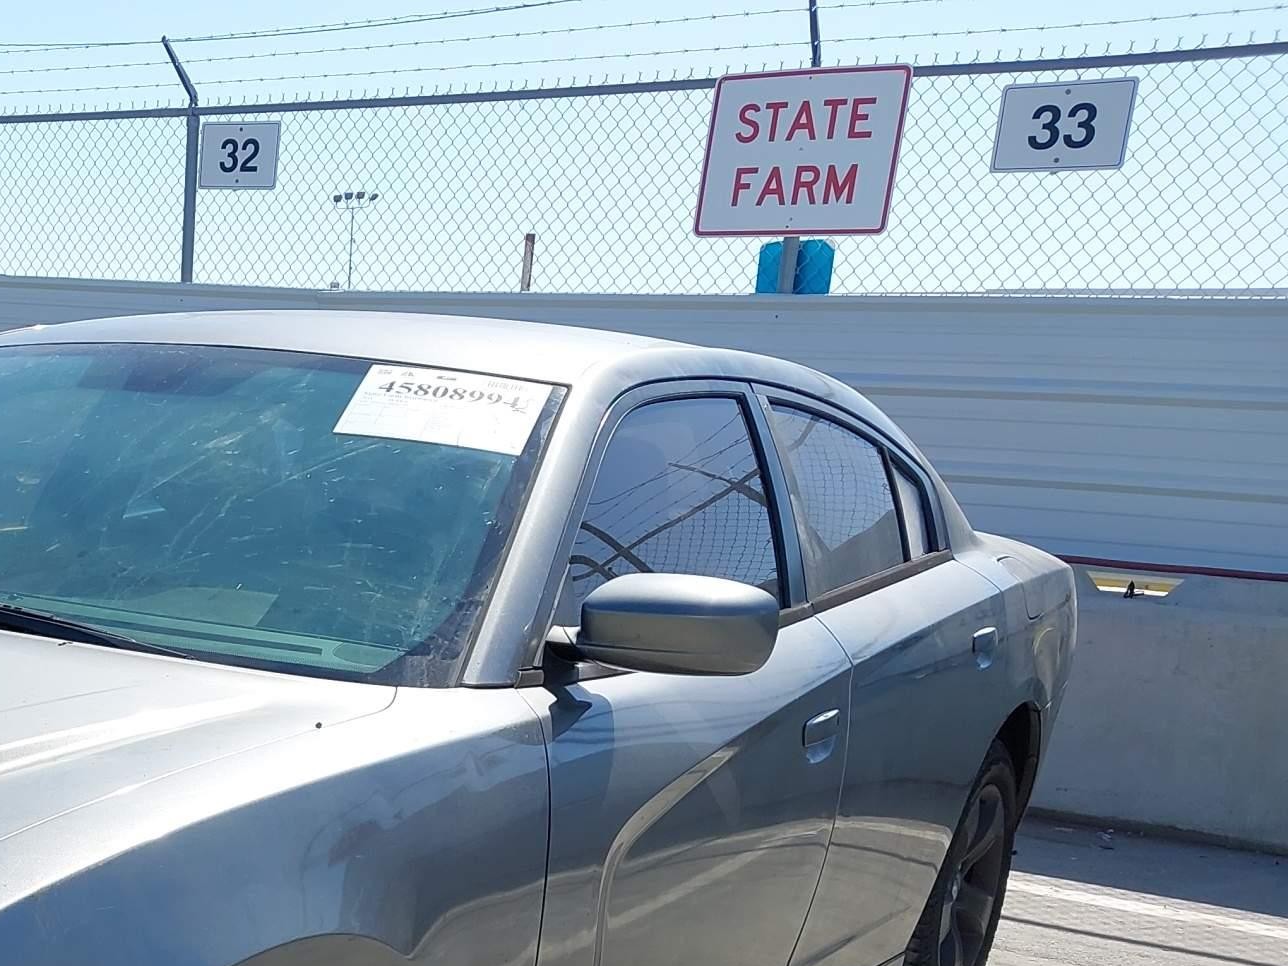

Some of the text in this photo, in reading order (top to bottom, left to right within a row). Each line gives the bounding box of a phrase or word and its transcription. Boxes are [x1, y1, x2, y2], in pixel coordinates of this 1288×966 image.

[735, 97, 877, 144] STATE
[1028, 102, 1097, 150] 33
[219, 138, 260, 173] 32
[731, 163, 859, 207] FARM
[378, 380, 521, 409] 45808994
